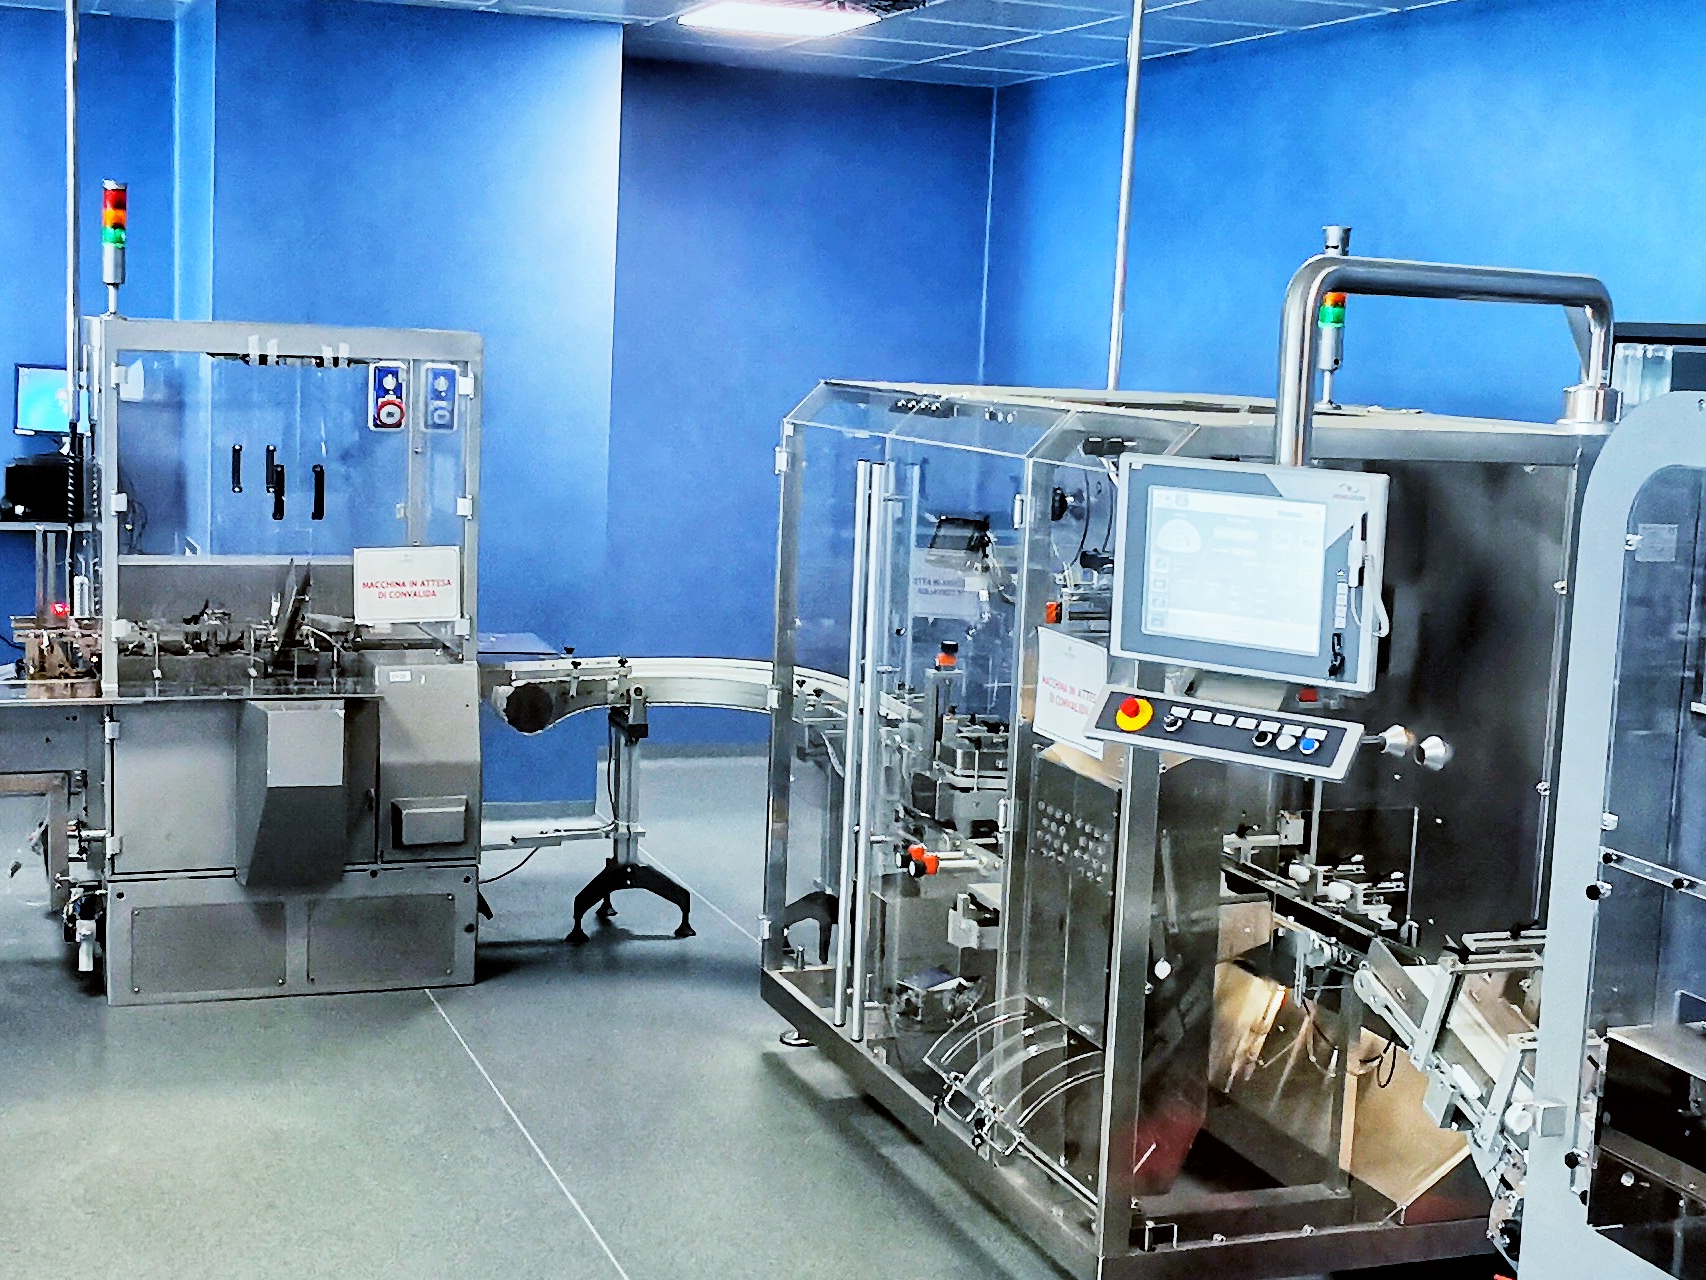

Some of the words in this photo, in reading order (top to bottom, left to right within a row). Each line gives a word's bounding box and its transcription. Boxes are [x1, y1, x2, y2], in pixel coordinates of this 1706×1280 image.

[362, 581, 406, 589] MACCHINA
[420, 579, 451, 587] ATTESA
[389, 590, 437, 599] CONVALIDA
